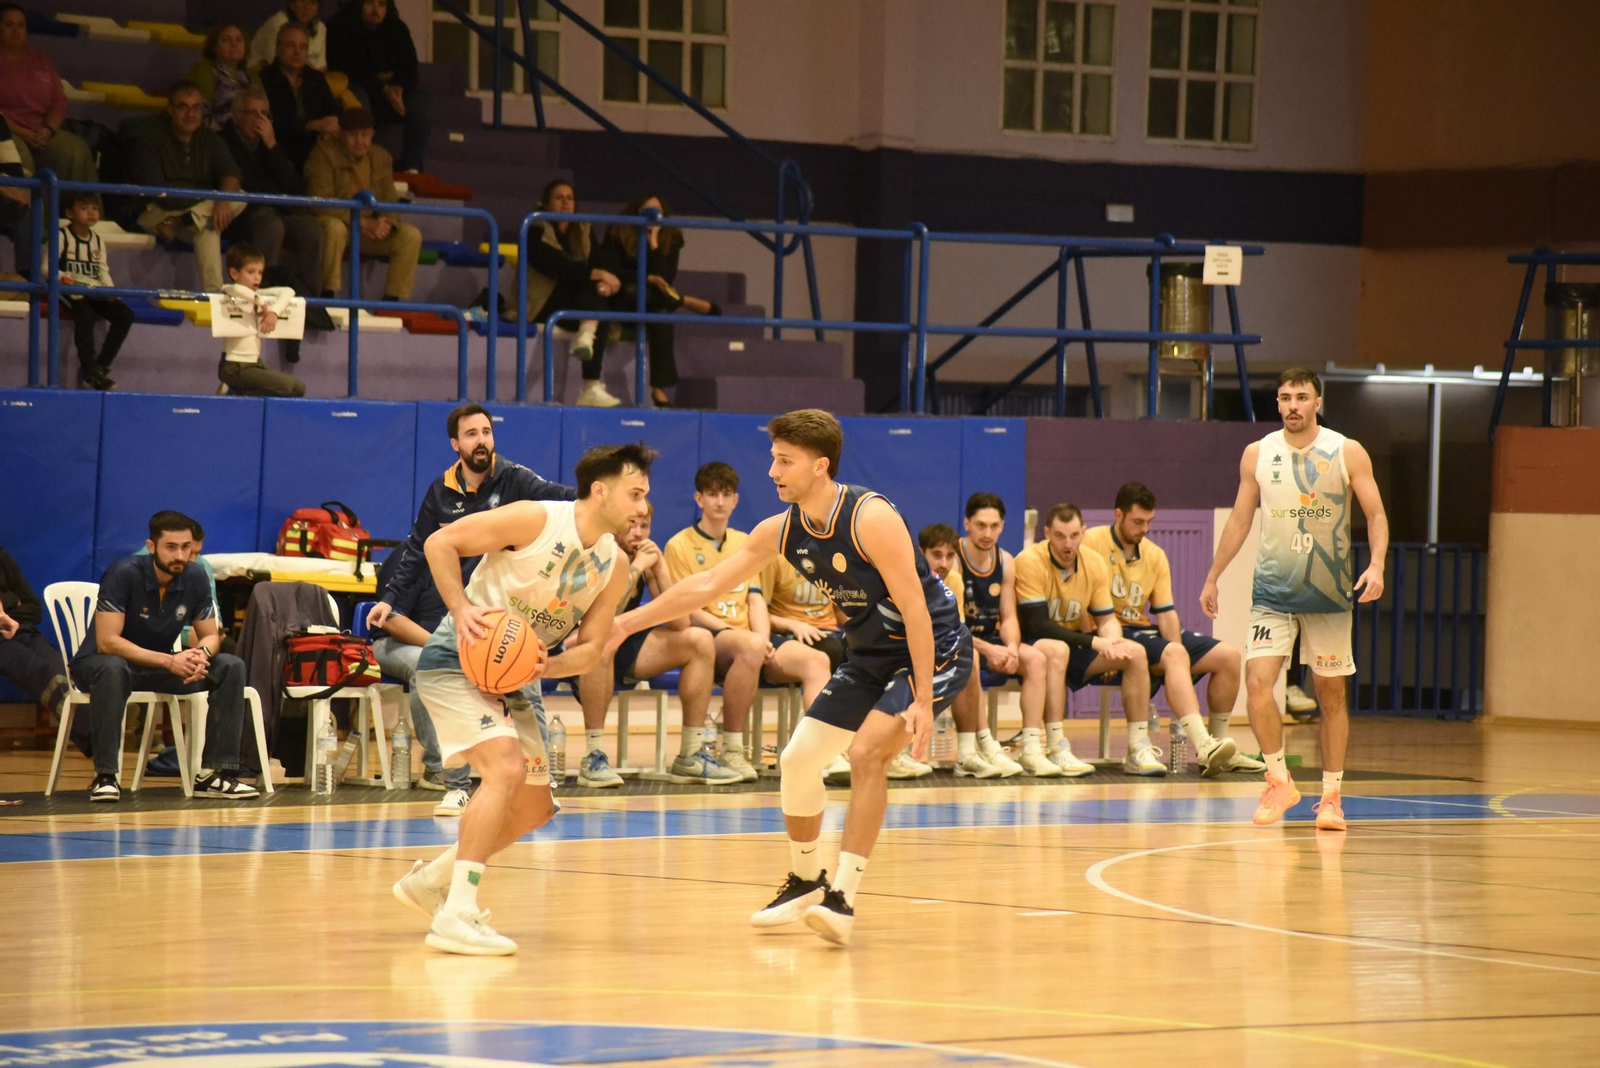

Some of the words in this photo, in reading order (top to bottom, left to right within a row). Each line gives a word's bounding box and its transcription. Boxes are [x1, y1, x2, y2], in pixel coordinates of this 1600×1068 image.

[1270, 505, 1332, 518] surseeds
[1290, 532, 1314, 555] 49
[508, 596, 567, 631] surseeds
[493, 618, 521, 665] Wilson
